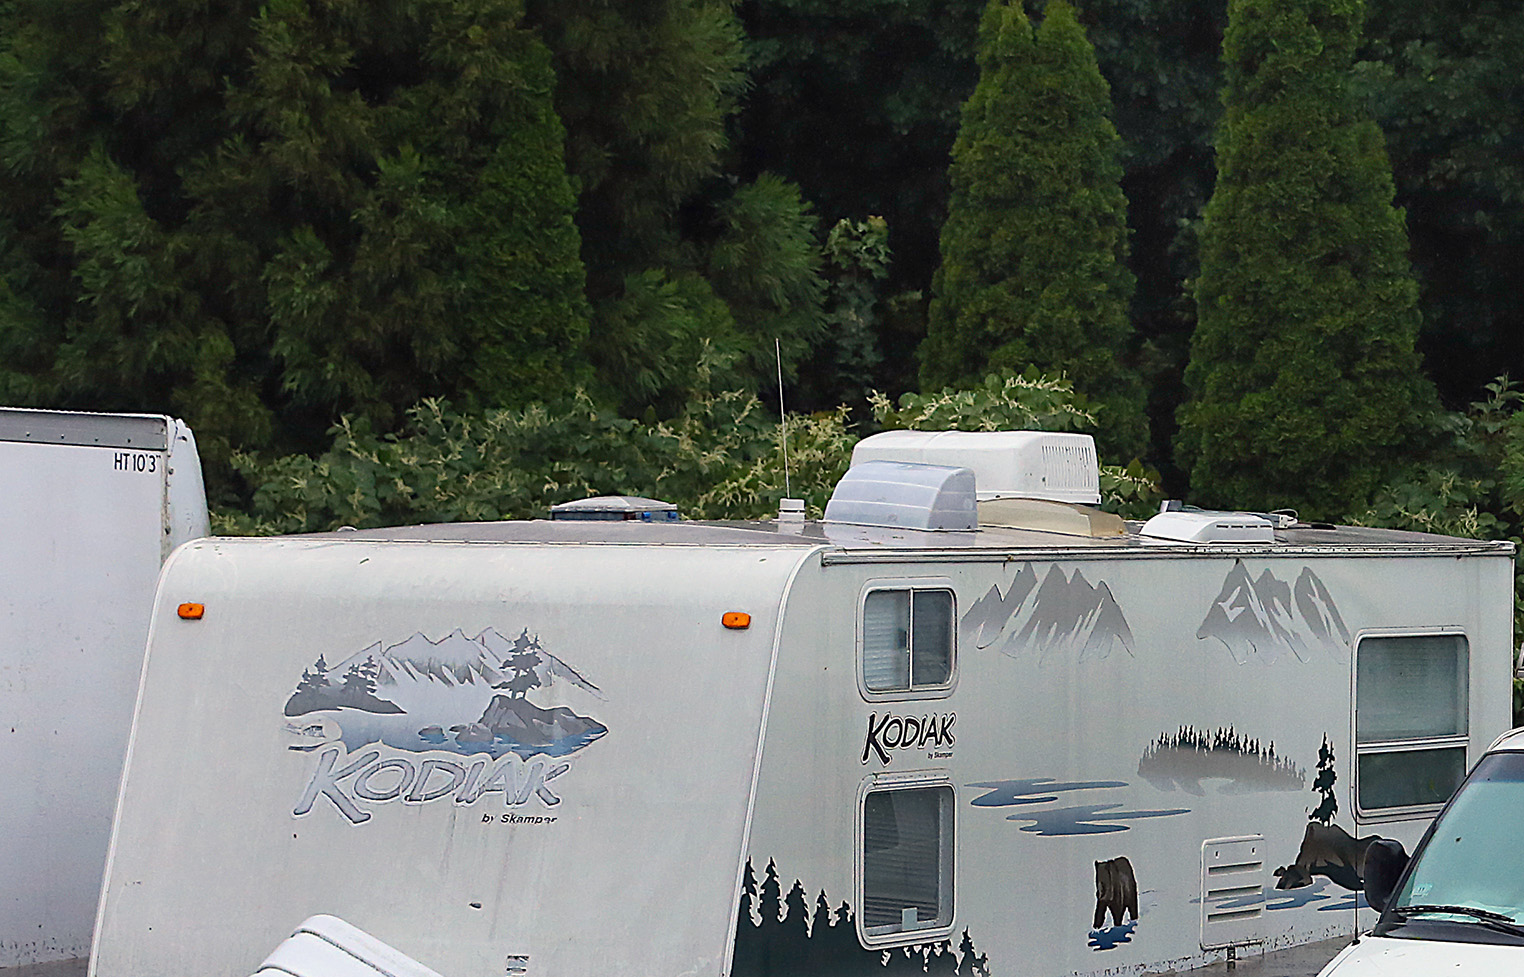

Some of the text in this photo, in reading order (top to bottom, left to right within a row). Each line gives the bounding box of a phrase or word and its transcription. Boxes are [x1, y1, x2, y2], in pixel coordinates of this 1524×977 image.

[114, 453, 130, 470] HT
[861, 711, 956, 767] KODIAK
[292, 748, 570, 825] KODIAK
